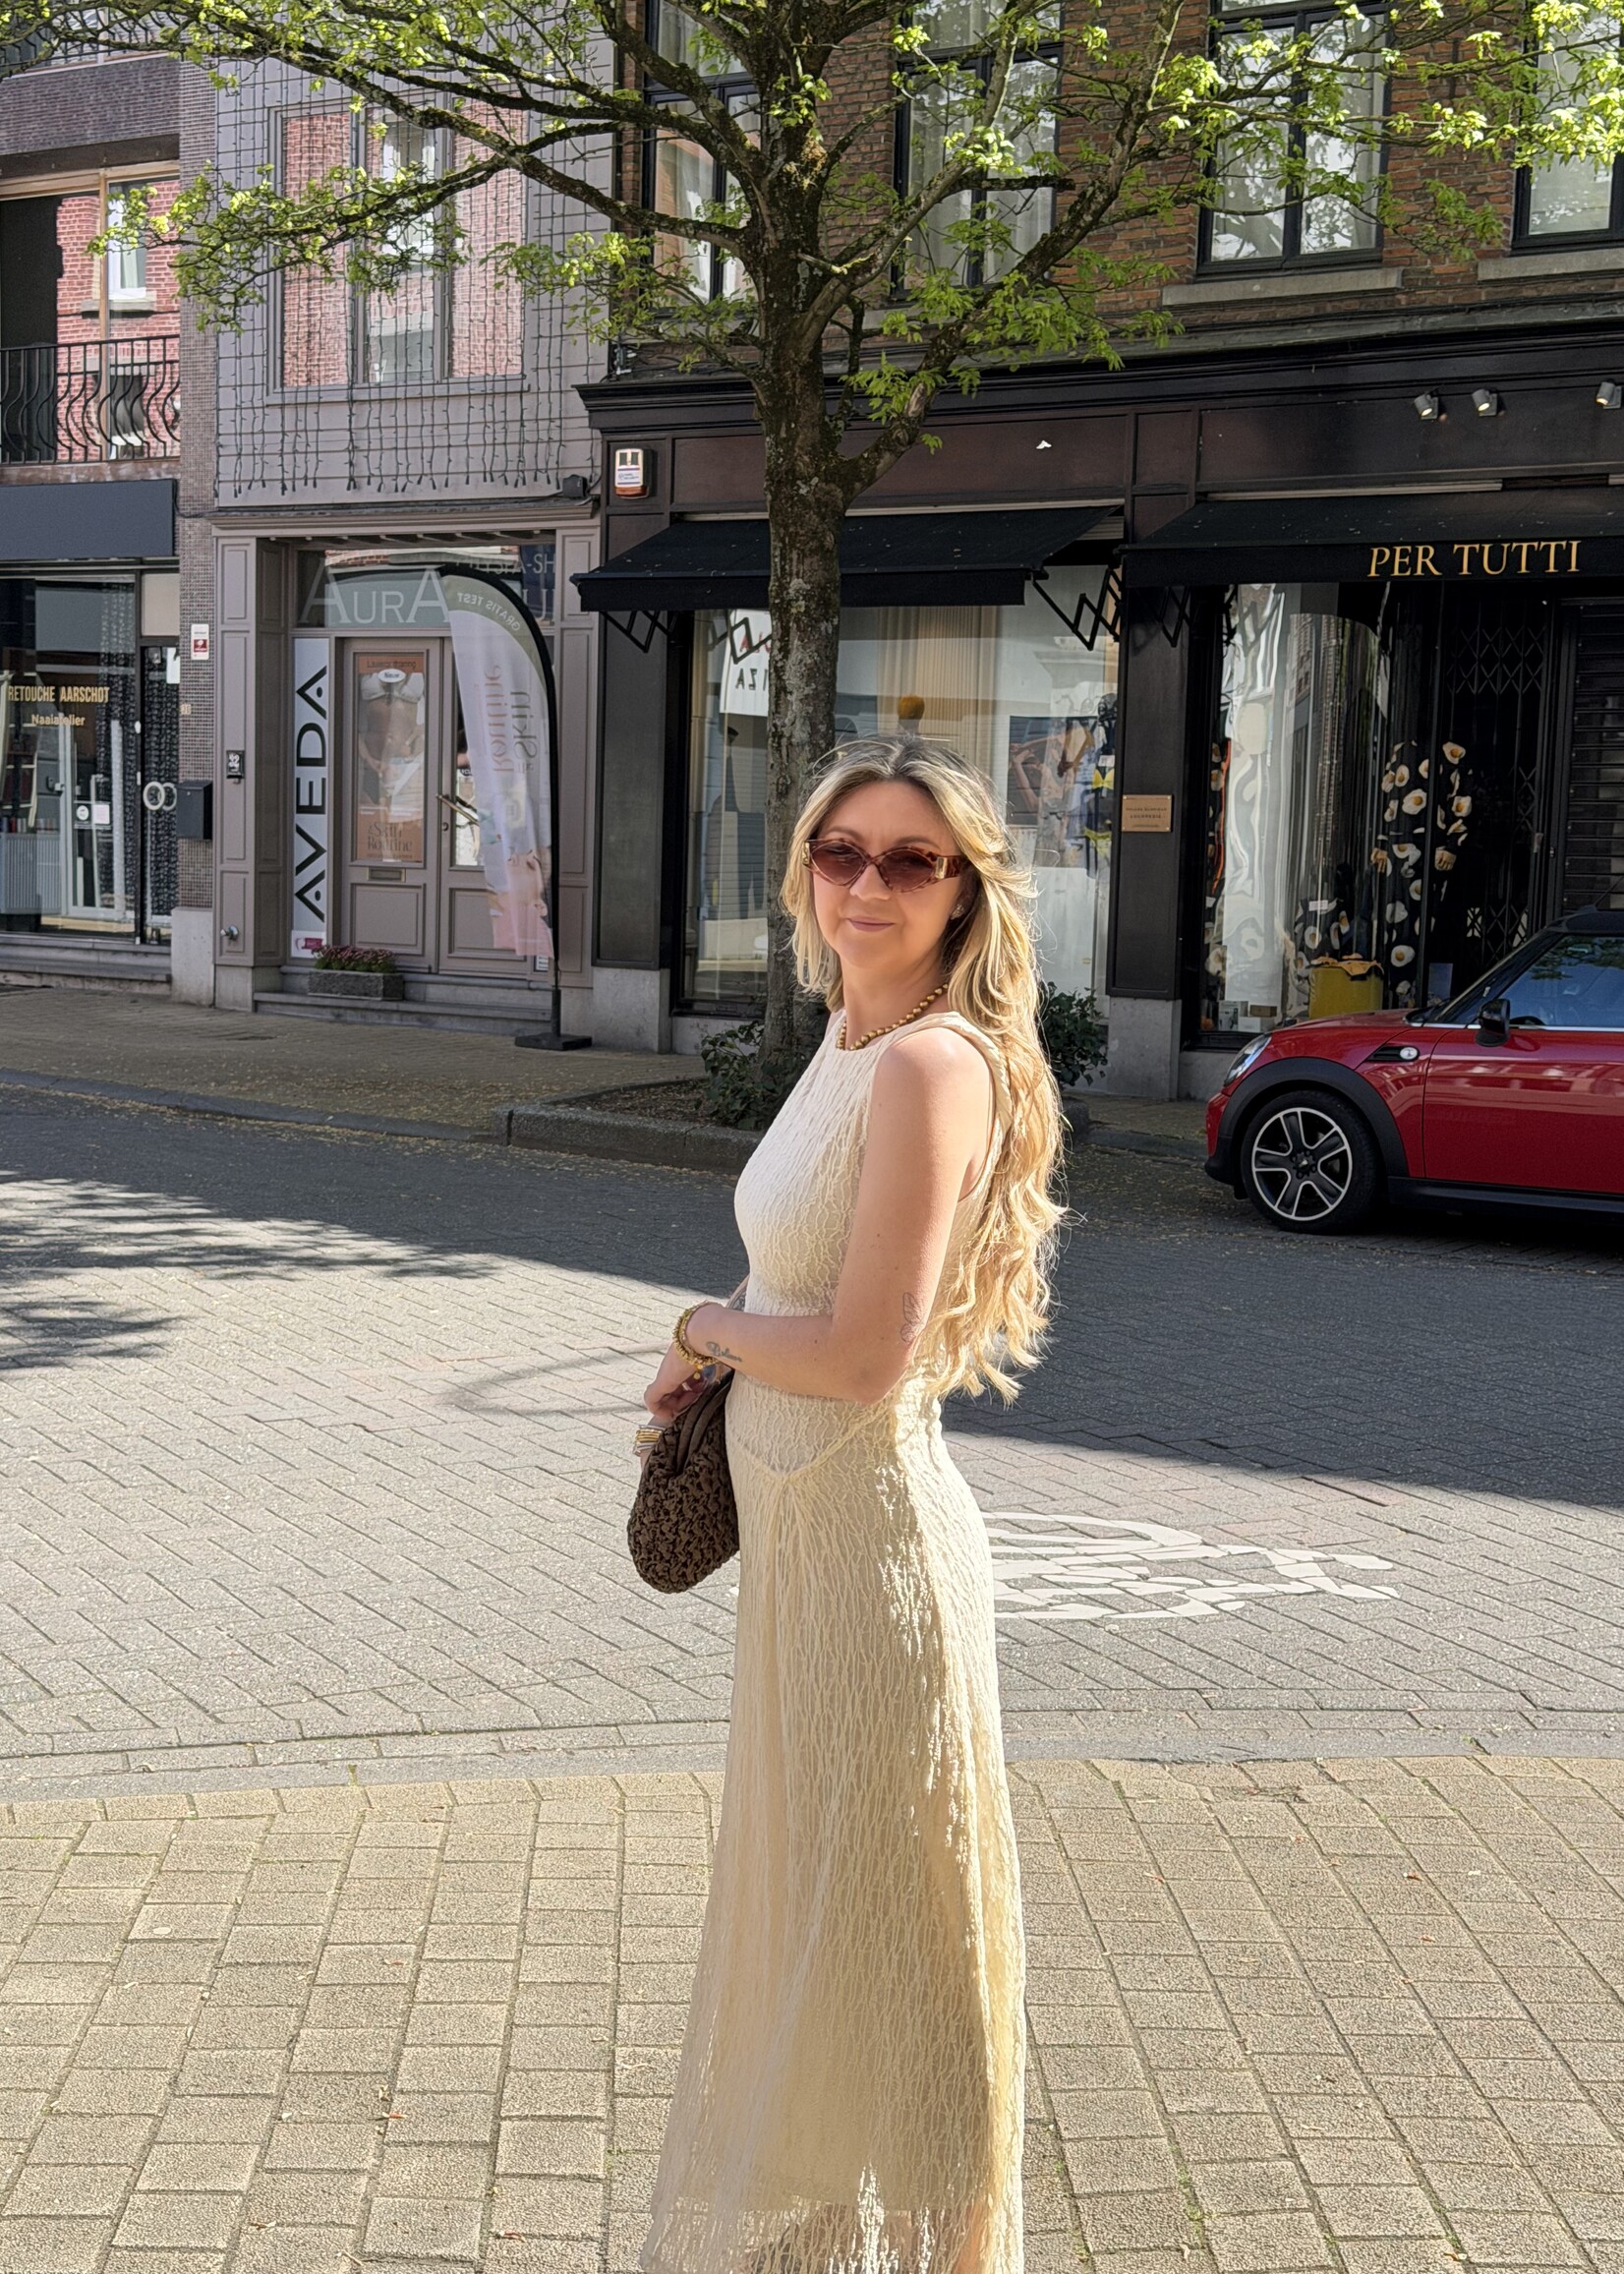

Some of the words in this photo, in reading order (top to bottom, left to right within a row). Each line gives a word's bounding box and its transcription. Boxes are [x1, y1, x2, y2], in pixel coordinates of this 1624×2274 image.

[1367, 545, 1443, 577] PER
[1452, 540, 1582, 576] TUTTI
[8, 685, 56, 702] RETOUCHE
[60, 686, 110, 703] AARSCHOT
[31, 714, 86, 727] Naaiatelier
[295, 666, 327, 923] AVEDA
